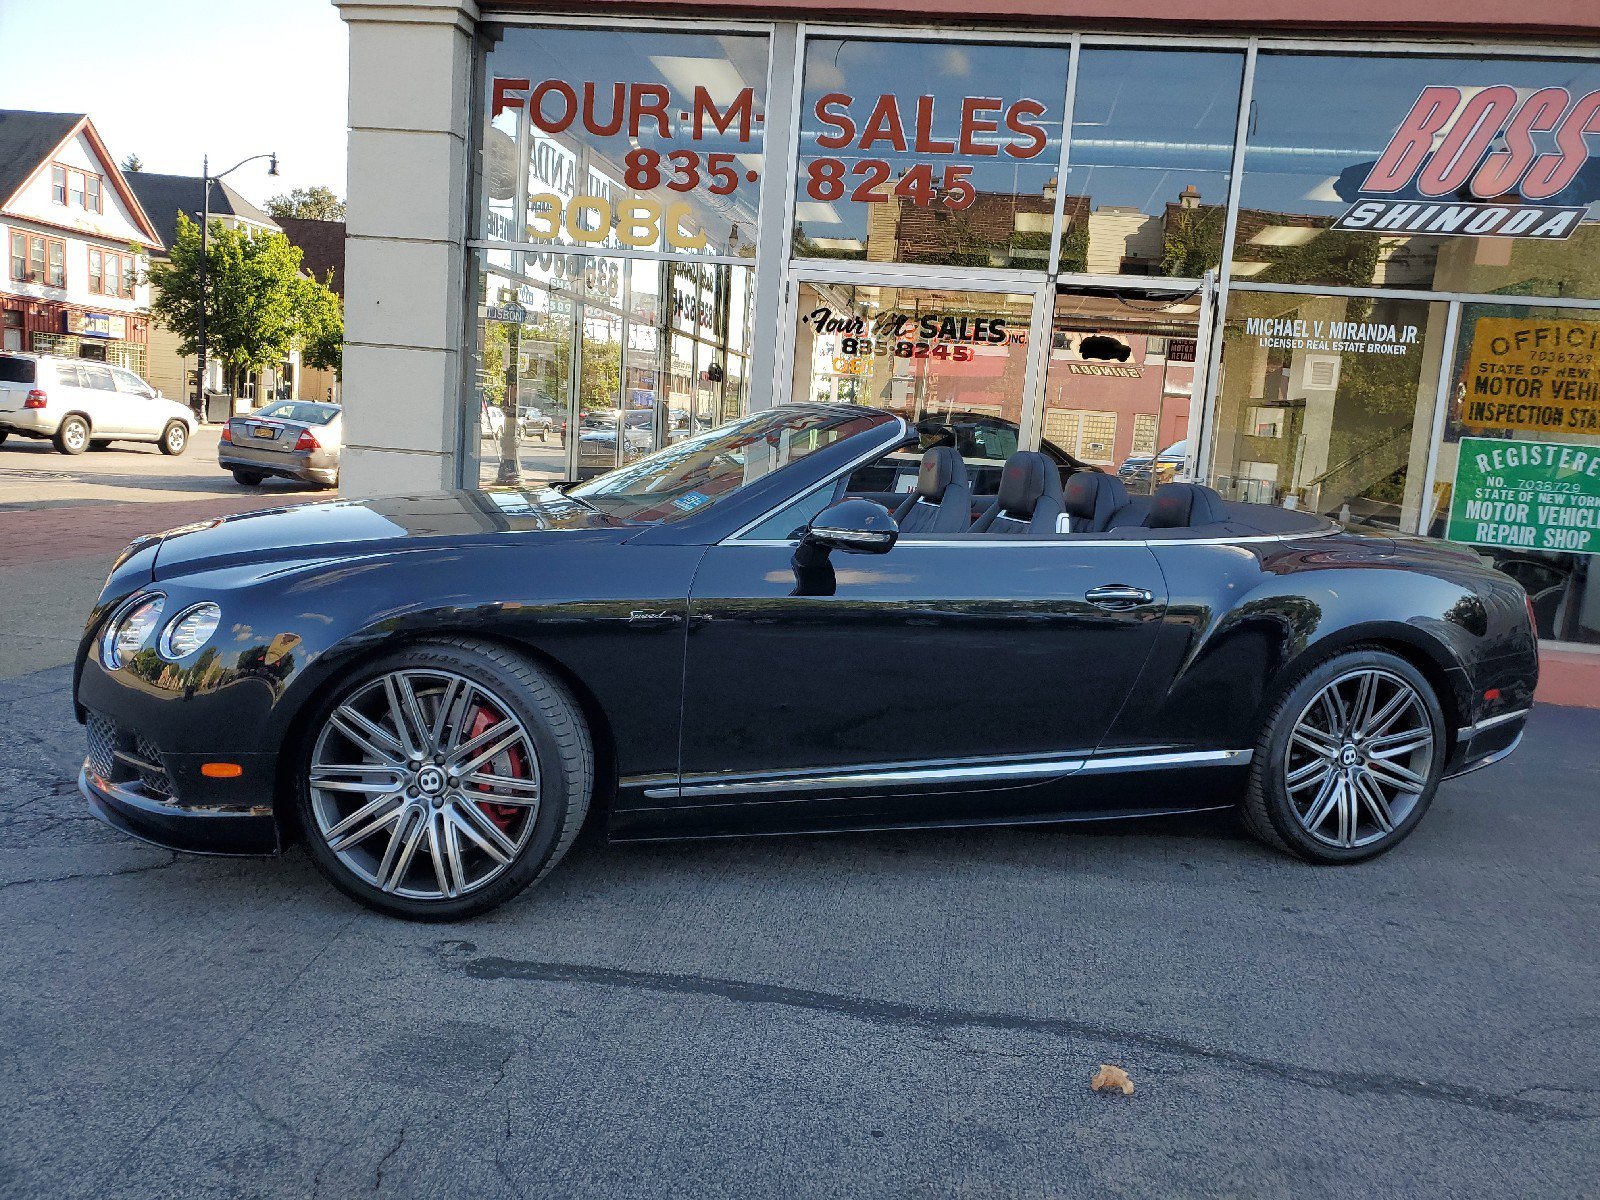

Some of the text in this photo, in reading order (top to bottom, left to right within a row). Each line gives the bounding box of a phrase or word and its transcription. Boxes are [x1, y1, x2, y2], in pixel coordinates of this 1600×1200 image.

[814, 93, 1048, 159] SALES
[1358, 84, 1600, 199] BOSS
[806, 158, 976, 211] 8245
[1341, 203, 1579, 237] SHINODA
[810, 307, 865, 335] Four
[919, 314, 1006, 343] SALES
[1246, 318, 1310, 338] MICHAEL
[1314, 320, 1325, 338] V.
[1329, 321, 1396, 343] MIRANDA
[1259, 338, 1407, 355] LICENSED REAL ESTATE BROKER
[1491, 327, 1600, 356] OFFICI
[1478, 363, 1525, 375] STATE
[1530, 365, 1551, 376] OF
[1556, 367, 1590, 379] NEW
[1474, 376, 1600, 401] MOTOR VEHI
[1468, 402, 1564, 426] INSPECTION
[1475, 445, 1600, 477] REGISTERE
[1475, 488, 1516, 501] STATE
[1518, 492, 1535, 502] OF
[1537, 493, 1566, 505] NEW
[1486, 477, 1581, 493] NO. 7038729
[1465, 500, 1530, 523] MOTOR
[1475, 522, 1592, 550] REPAIR SHOP
